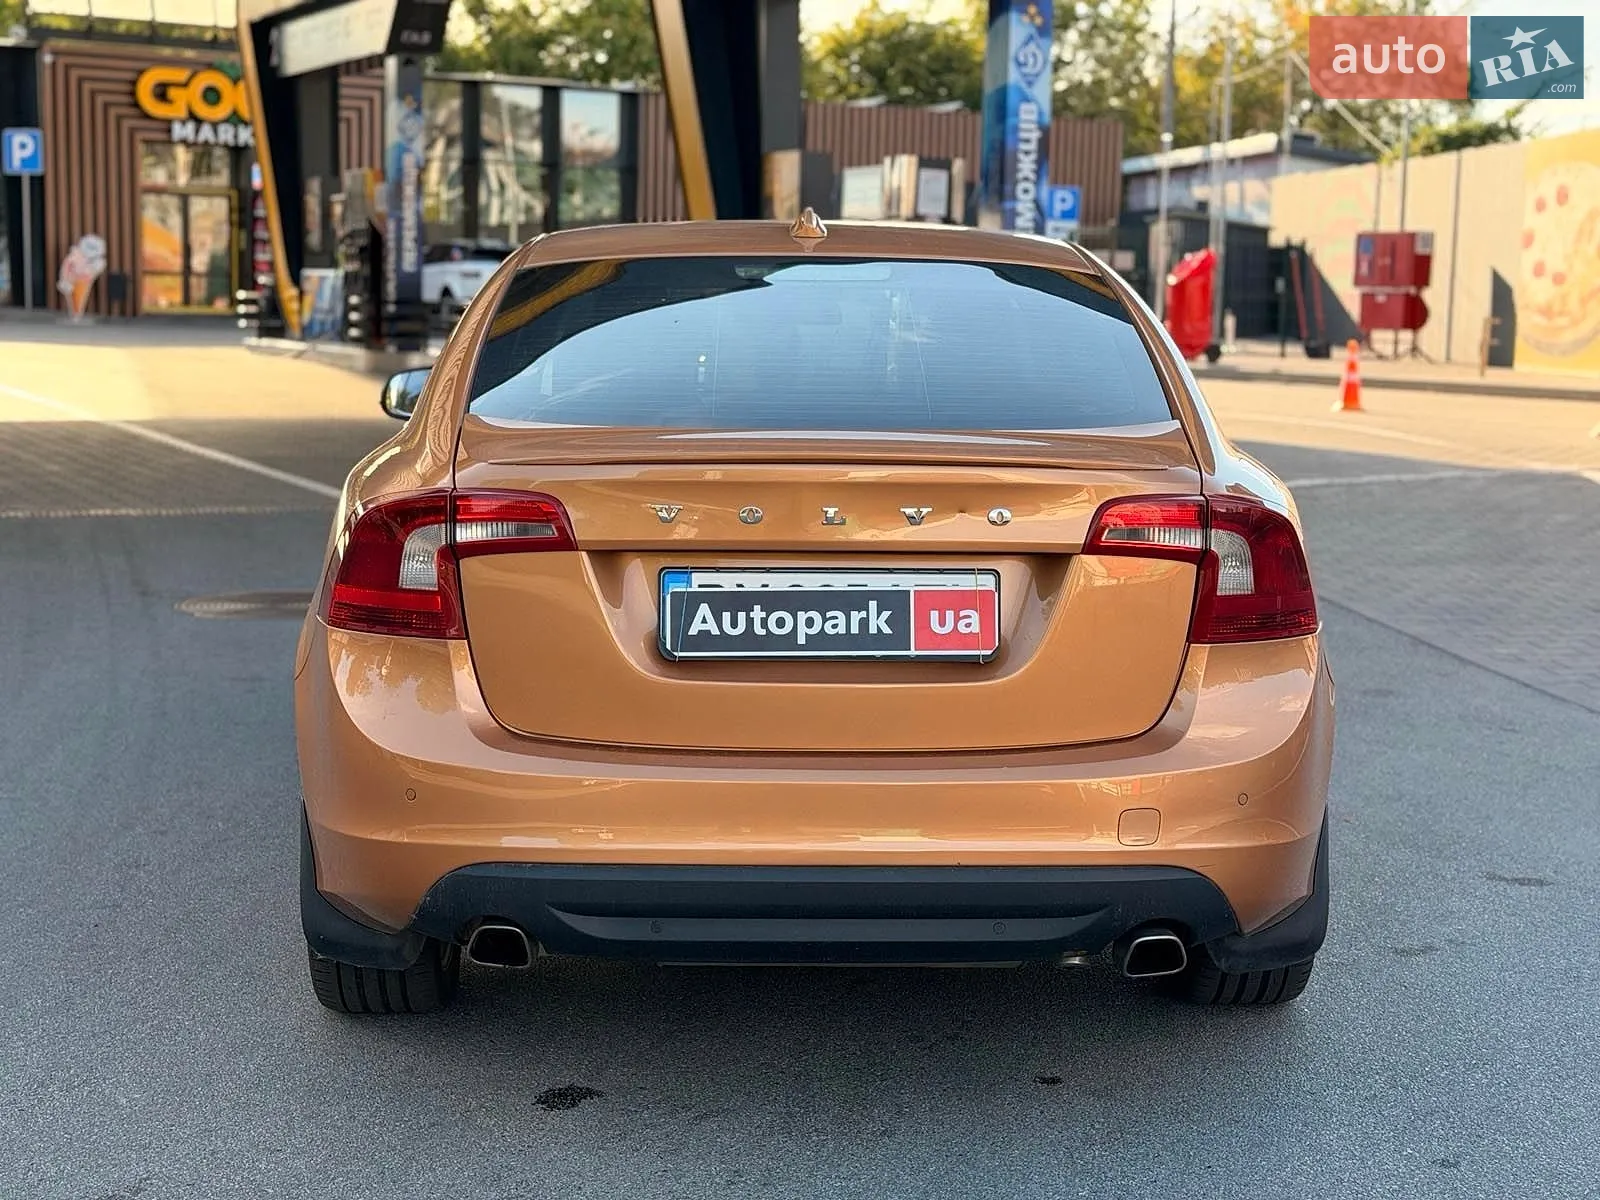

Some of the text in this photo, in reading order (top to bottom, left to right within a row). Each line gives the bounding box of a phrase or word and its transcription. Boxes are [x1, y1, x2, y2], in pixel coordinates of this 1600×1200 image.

[11, 132, 35, 169] P
[1014, 101, 1042, 235] МОЖЦІВ
[1053, 189, 1074, 217] P
[652, 504, 1013, 526] VOLVO
[688, 600, 980, 646] Autopark ua
